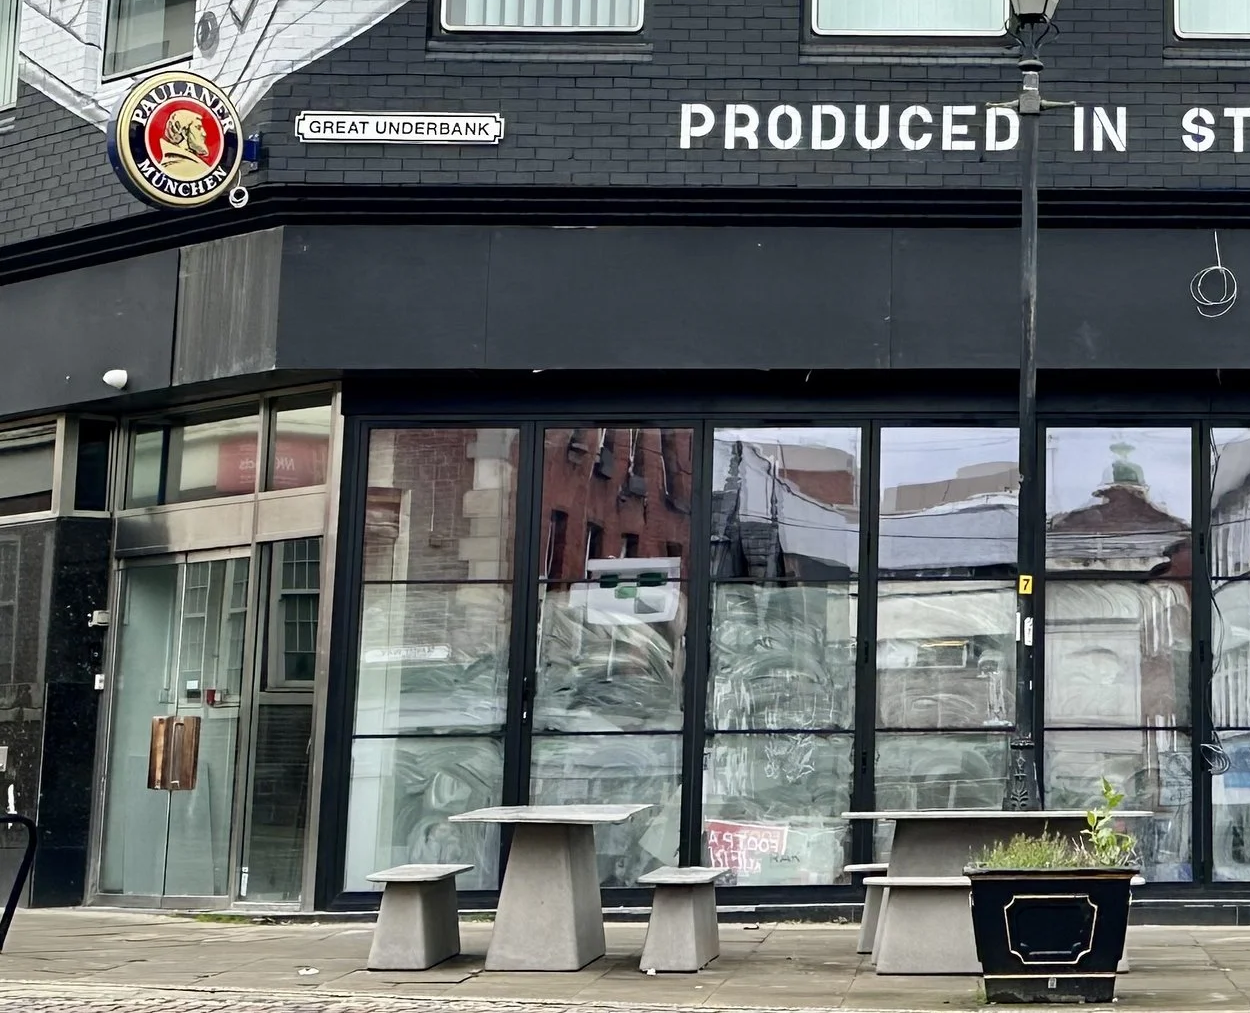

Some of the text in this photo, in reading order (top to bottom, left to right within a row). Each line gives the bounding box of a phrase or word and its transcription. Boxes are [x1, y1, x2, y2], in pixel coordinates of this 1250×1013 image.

[131, 81, 234, 134] PAULANER
[680, 103, 1020, 151] PRODUCED
[1074, 105, 1127, 152] IN
[309, 121, 490, 136] GREAT UNDERBANK
[137, 158, 228, 198] MÜNCHEN
[1023, 579, 1030, 591] 7
